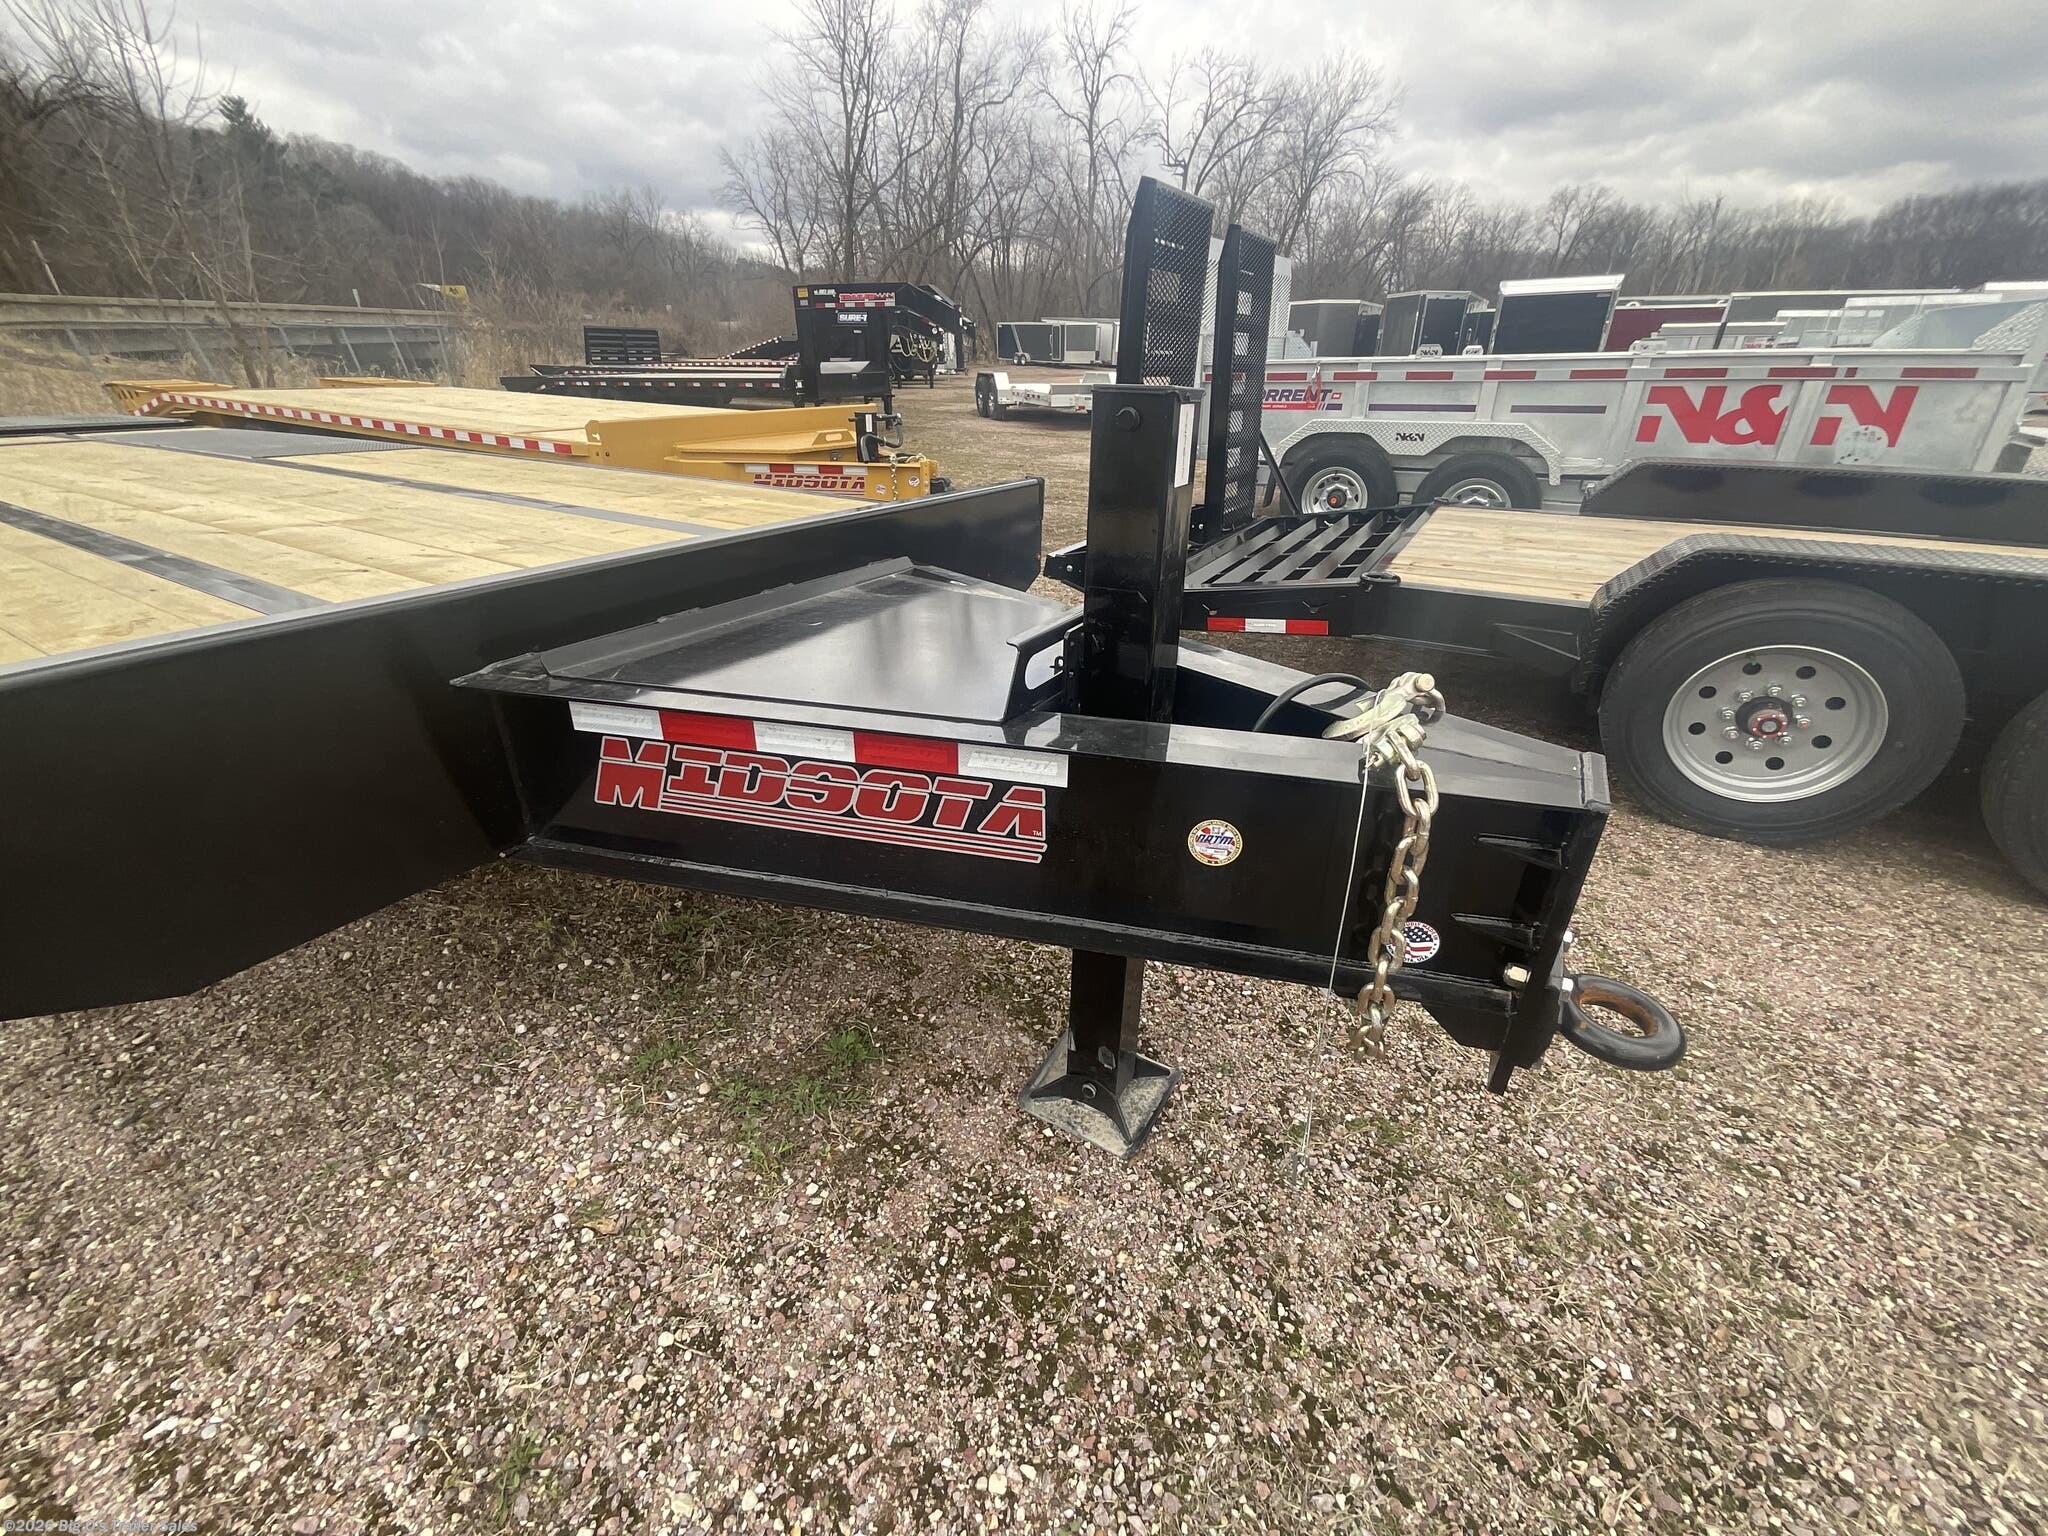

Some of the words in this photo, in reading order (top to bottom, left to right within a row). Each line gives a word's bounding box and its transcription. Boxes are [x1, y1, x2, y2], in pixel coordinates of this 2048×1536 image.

[1263, 384, 1333, 402] RRENT
[753, 473, 866, 490] MIDSOTA
[595, 735, 1047, 841] MIDSOTA
